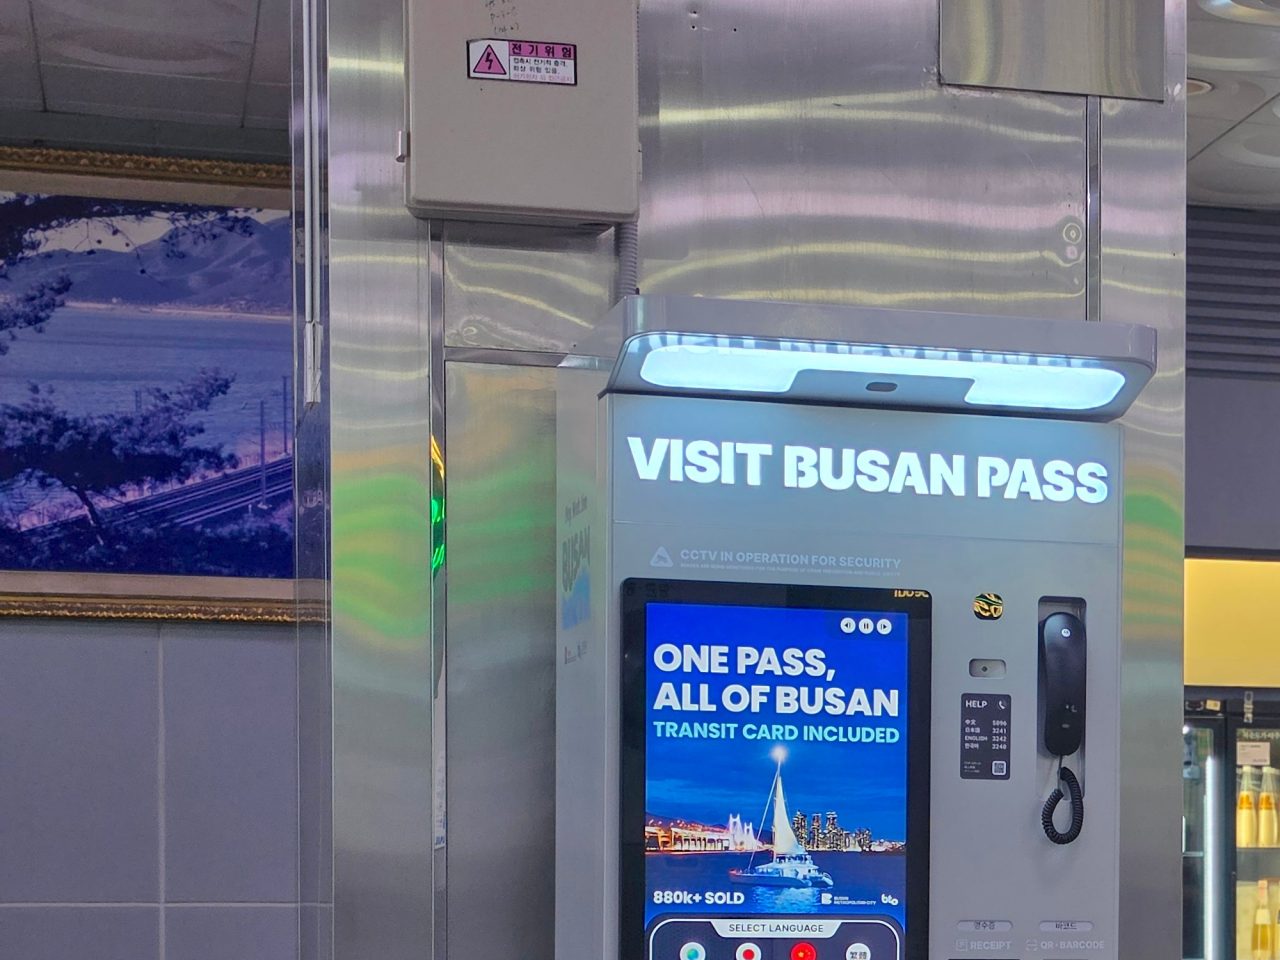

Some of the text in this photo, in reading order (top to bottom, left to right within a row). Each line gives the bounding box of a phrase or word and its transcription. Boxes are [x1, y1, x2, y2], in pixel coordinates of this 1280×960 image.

[627, 436, 1109, 504] VISIT BUSAN PASS
[680, 549, 902, 569] CCTV IN OPERATION FOR SECURITY
[653, 643, 836, 682] ONE PASS,
[652, 682, 899, 717] ALL OF BUSAN
[965, 700, 988, 708] HELP
[653, 720, 900, 744] TRANSIT CARD INCLUDED
[653, 890, 745, 906] 880k+ SOLD
[728, 923, 825, 933] SELECT LANGUAGE
[970, 940, 1012, 950] RECEIPT
[1060, 940, 1105, 949] BARCODE
